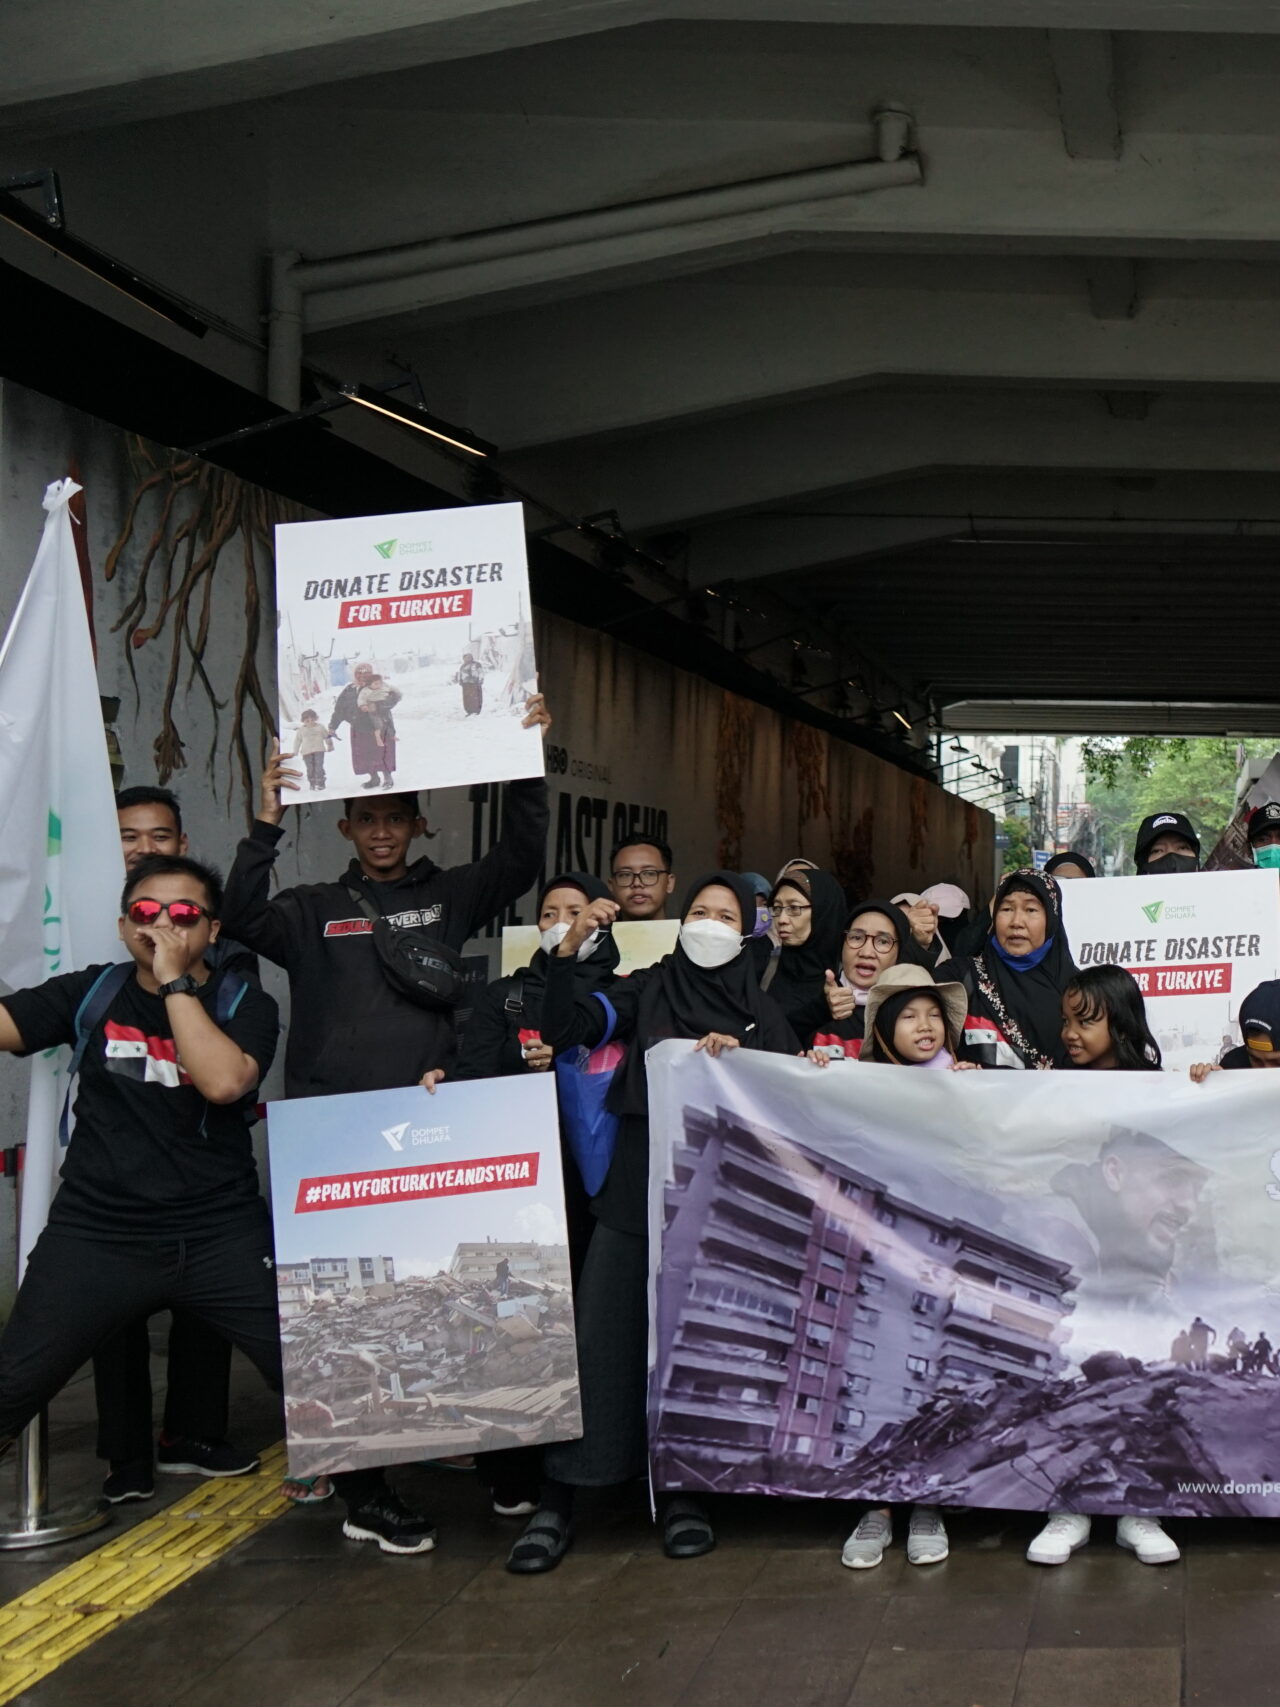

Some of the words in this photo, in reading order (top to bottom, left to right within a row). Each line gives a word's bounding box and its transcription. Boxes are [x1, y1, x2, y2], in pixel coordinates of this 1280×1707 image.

[304, 573, 391, 601] DONATE
[399, 562, 504, 592] DISASTER
[347, 601, 382, 623] FOR
[390, 594, 465, 620] TURKIYE
[546, 744, 568, 775] HBO
[1079, 938, 1158, 965] DONATE
[1164, 934, 1261, 961] DISASTER
[1132, 972, 1150, 991] OR
[1156, 968, 1224, 991] TURKIYE
[411, 1125, 450, 1138] DOMPET
[411, 1134, 452, 1146] DHUAFA
[305, 1160, 530, 1204] #PRAYFORTURKIYEANDSYRIA
